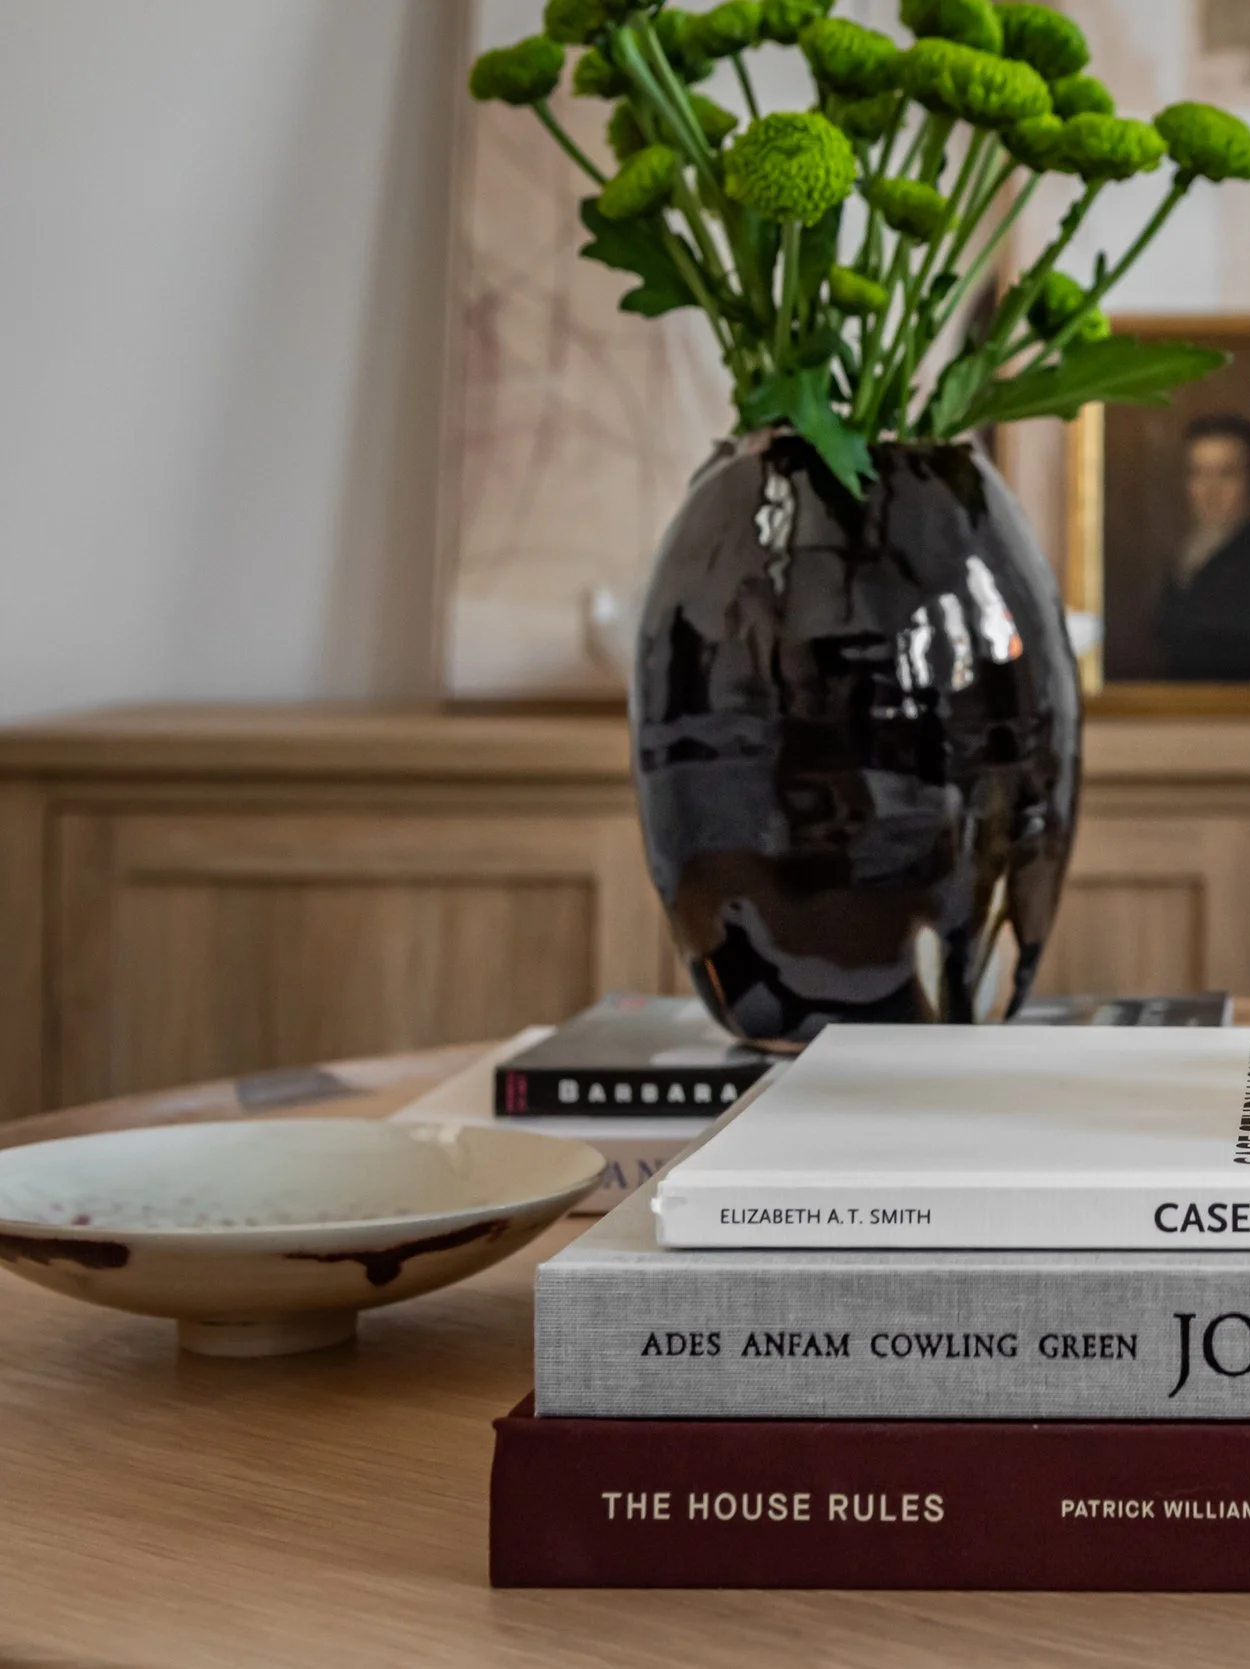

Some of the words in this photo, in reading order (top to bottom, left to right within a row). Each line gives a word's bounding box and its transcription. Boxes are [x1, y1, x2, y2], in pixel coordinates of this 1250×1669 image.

[558, 1077, 738, 1104] BARBARA
[720, 1208, 821, 1226] ELIZABETH
[870, 1208, 931, 1226] SMITH
[1154, 1202, 1250, 1233] CASE
[641, 1332, 721, 1357] ADES
[741, 1331, 850, 1358] ANFAM
[870, 1332, 1018, 1358] COWLING
[1038, 1332, 1138, 1359] GREEN
[602, 1491, 671, 1521] THE
[688, 1491, 810, 1522] HOUSE
[829, 1493, 945, 1523] RULES
[1060, 1499, 1155, 1520] PATRICK
